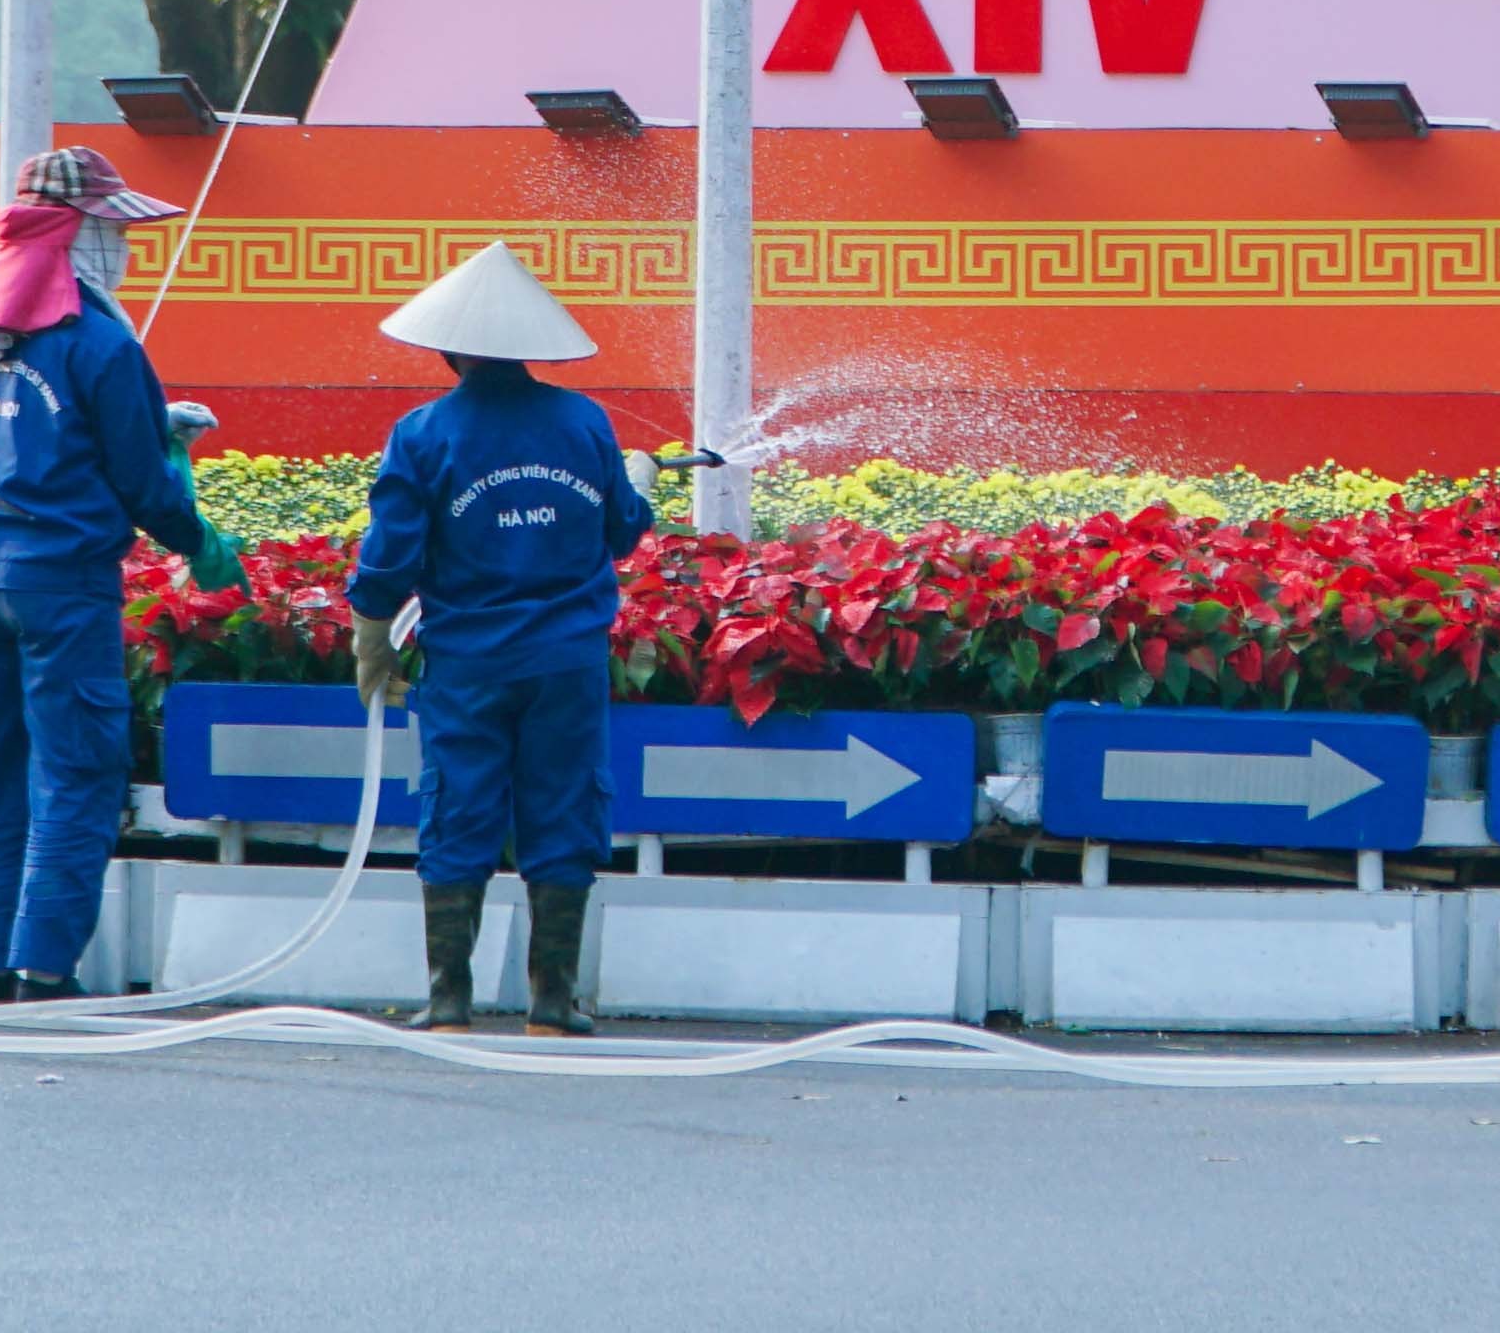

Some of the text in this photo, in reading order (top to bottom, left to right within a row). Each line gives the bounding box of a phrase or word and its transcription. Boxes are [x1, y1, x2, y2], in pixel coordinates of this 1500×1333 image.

[451, 464, 604, 518] CÔNG TY CÔNG VIÊN CÂY XANH
[497, 506, 557, 529] HÀ NỘI
